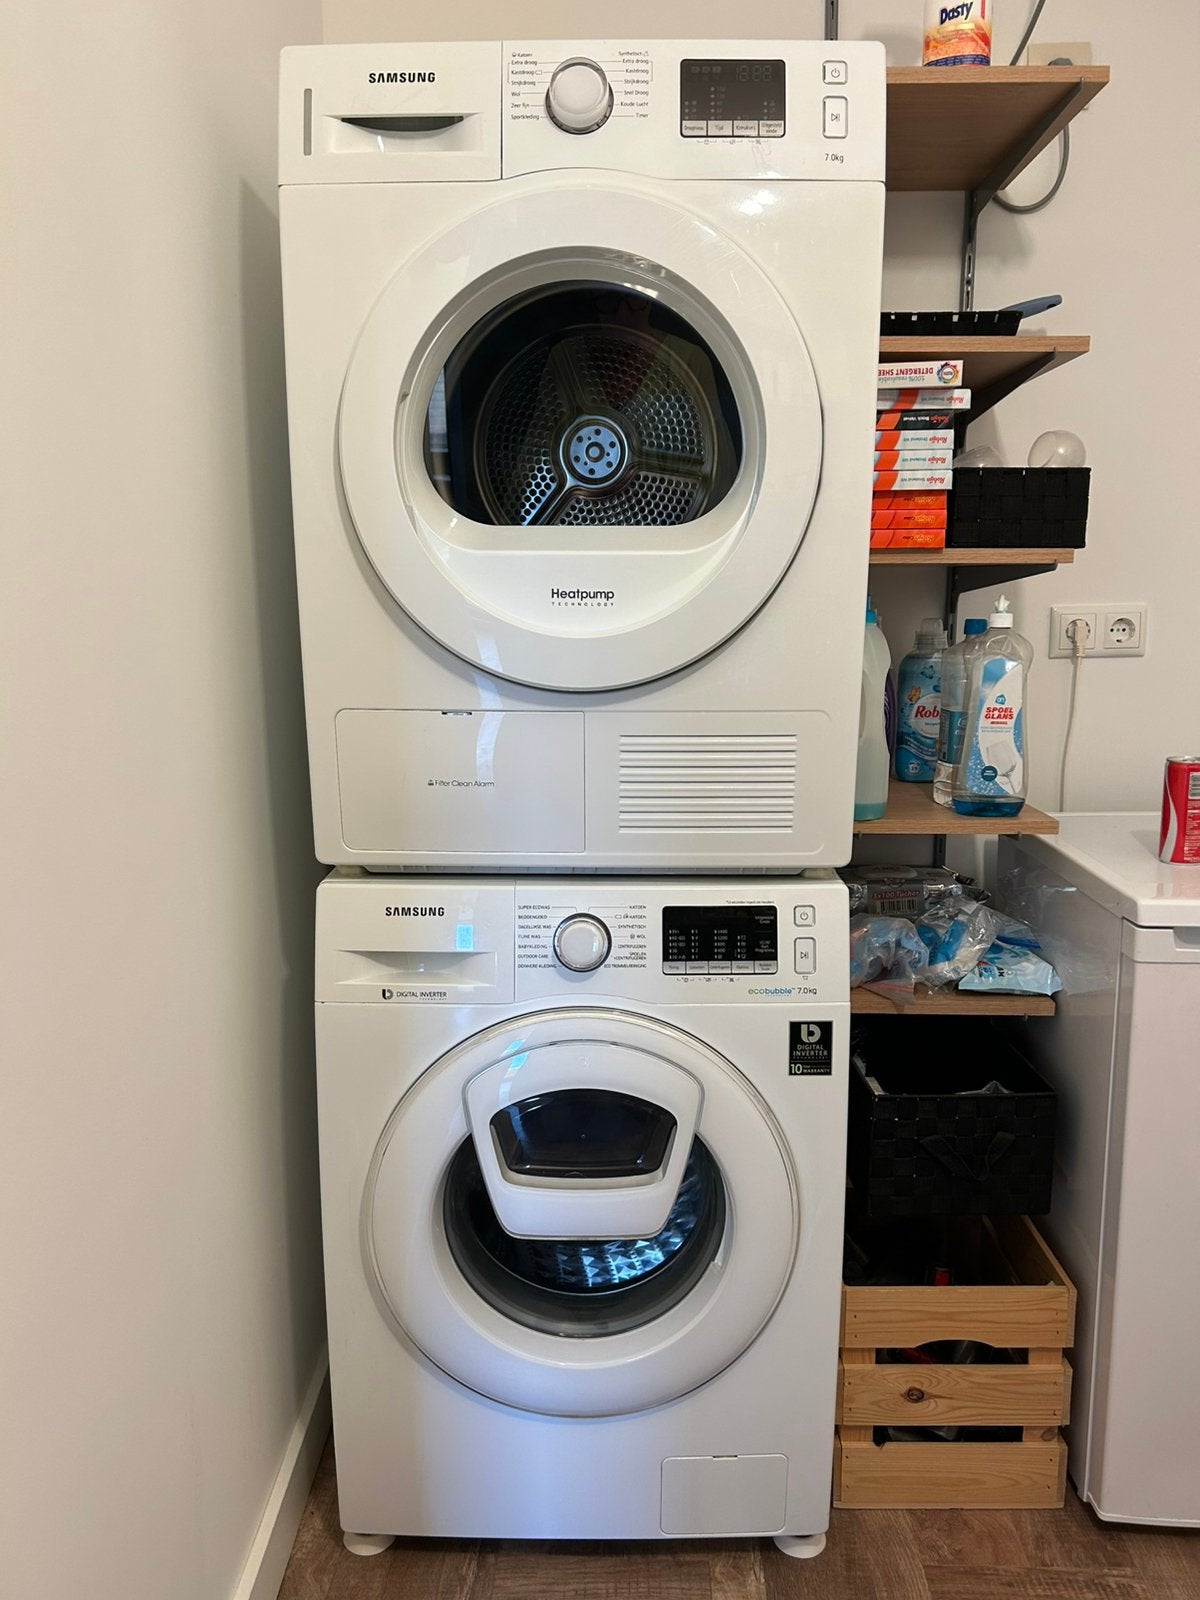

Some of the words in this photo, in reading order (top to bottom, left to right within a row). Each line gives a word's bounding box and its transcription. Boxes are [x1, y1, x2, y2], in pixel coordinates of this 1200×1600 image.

[940, 2, 974, 25] Dasty
[368, 72, 436, 84] SAMSUNG
[825, 153, 844, 163] 7.0kg
[551, 588, 614, 601] Heatpump
[385, 906, 445, 916] SAMSUNG
[791, 1064, 802, 1074] 10
